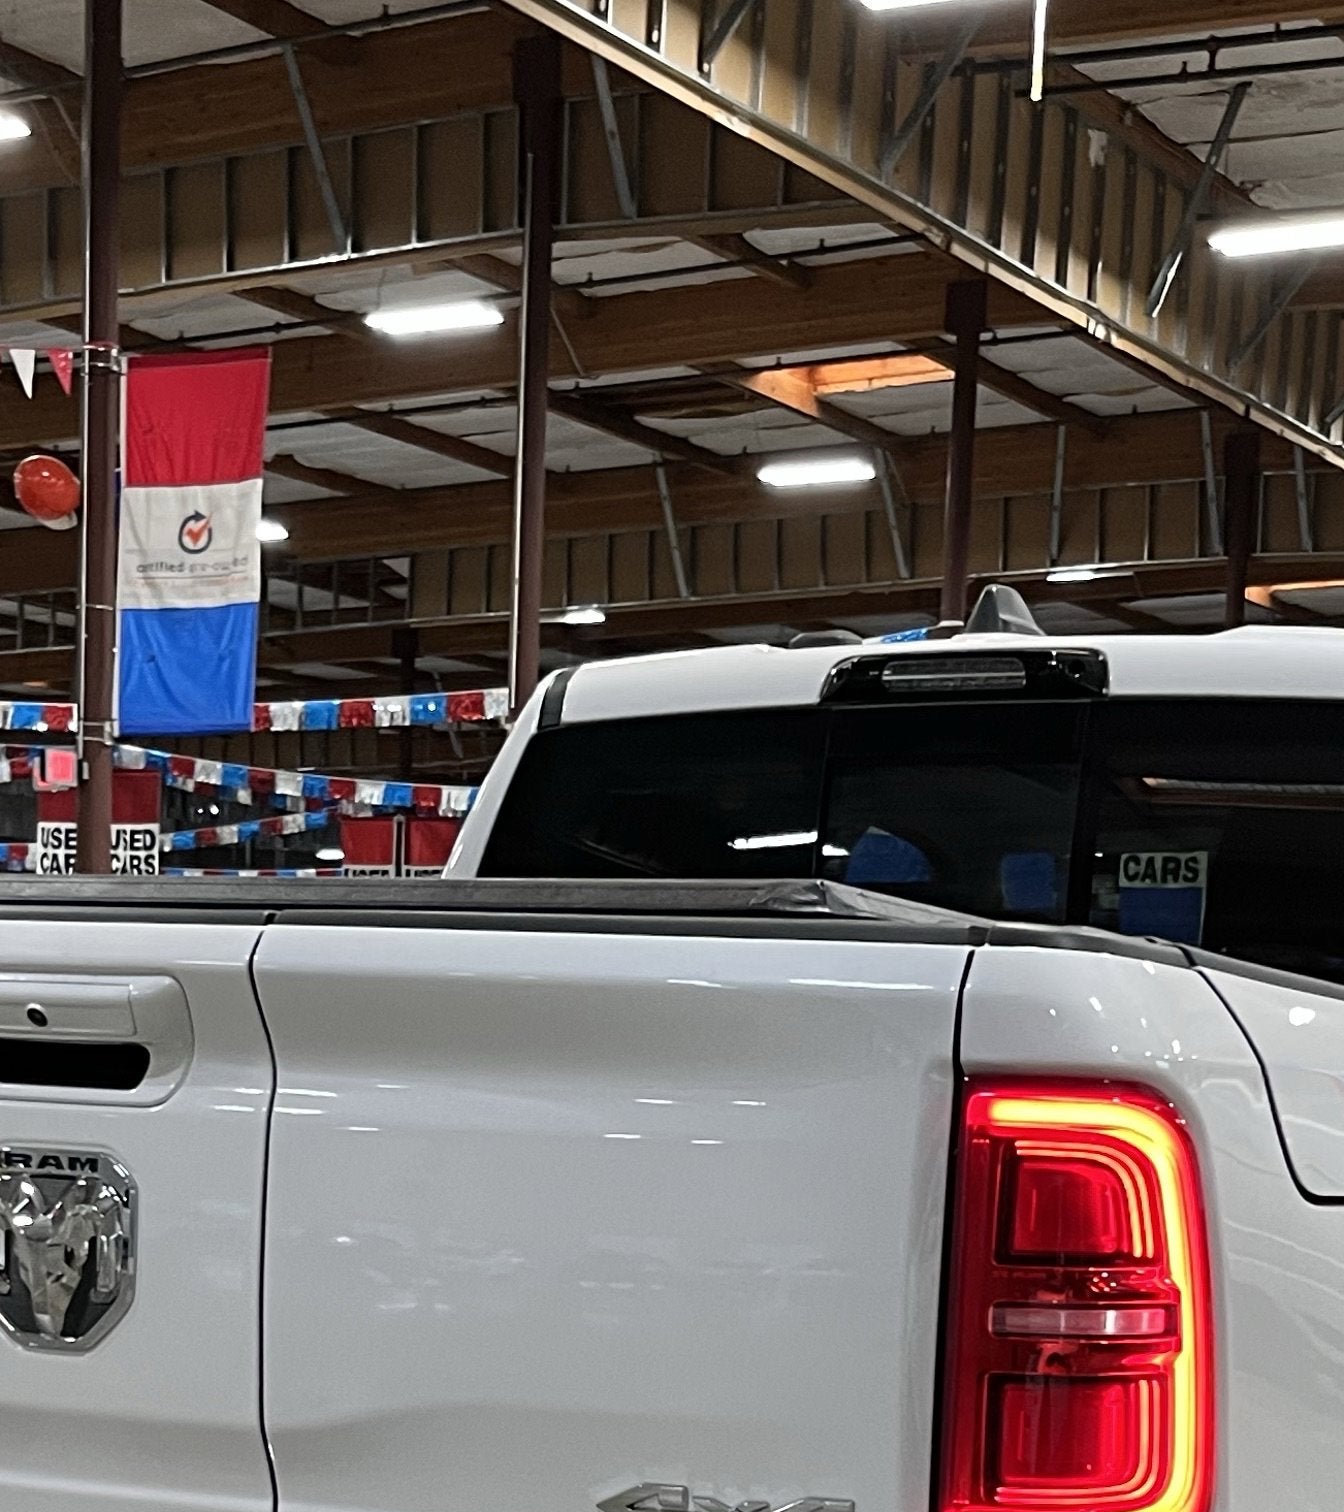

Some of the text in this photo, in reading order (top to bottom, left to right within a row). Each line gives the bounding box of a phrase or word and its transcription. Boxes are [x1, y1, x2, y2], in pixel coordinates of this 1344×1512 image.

[41, 827, 77, 849] USE
[1123, 855, 1199, 884] CARS
[3, 1153, 99, 1173] RAM
